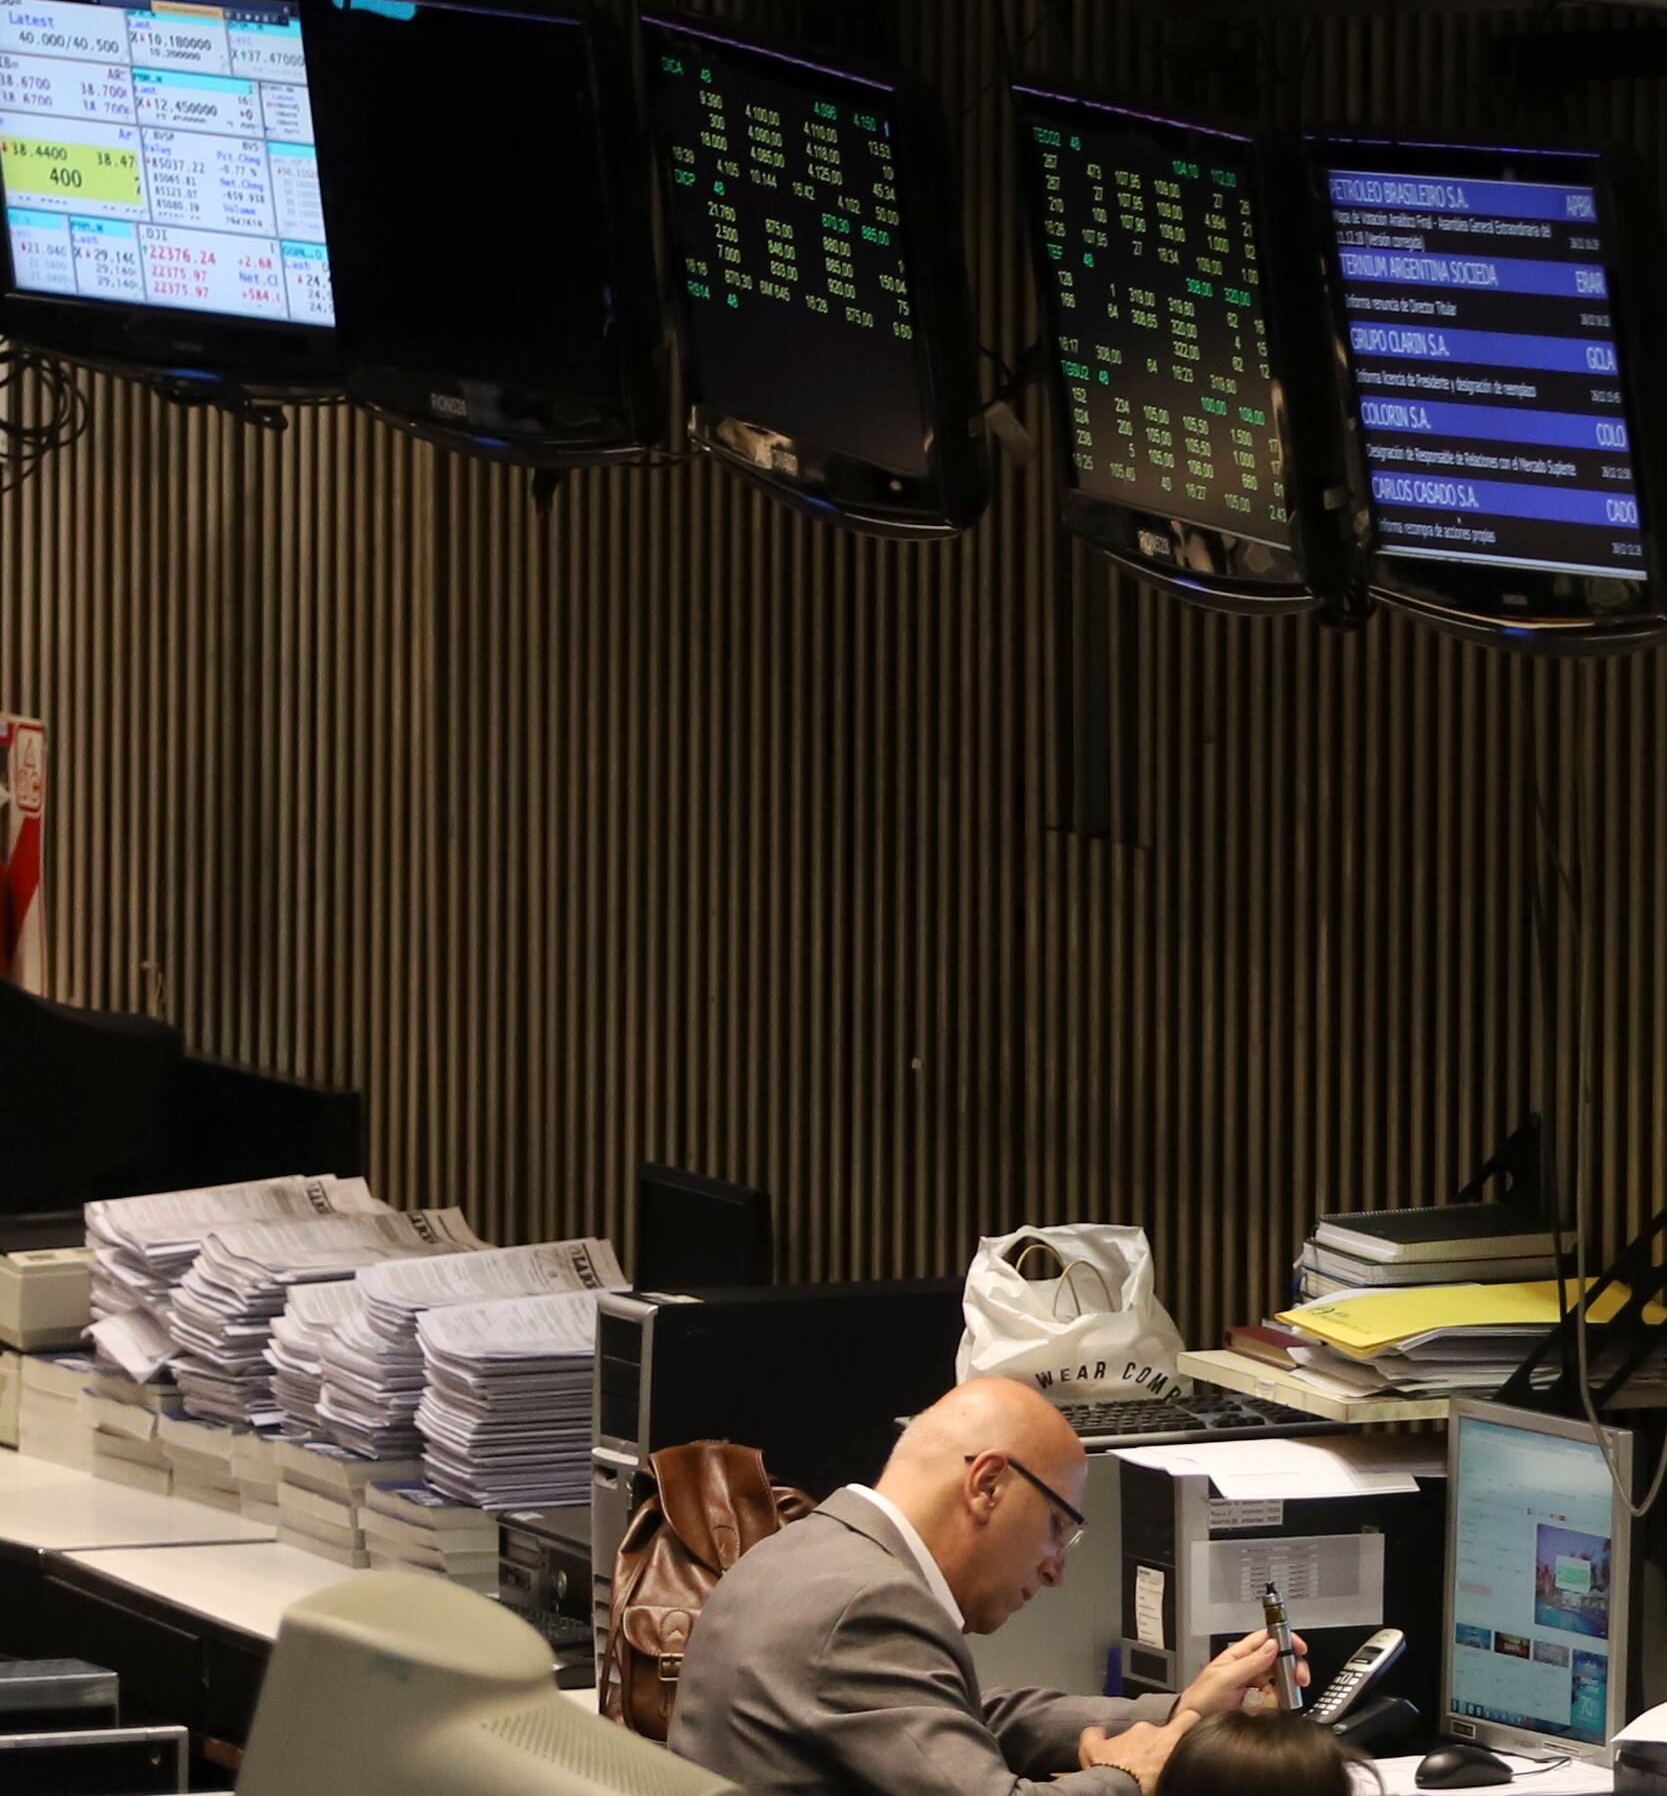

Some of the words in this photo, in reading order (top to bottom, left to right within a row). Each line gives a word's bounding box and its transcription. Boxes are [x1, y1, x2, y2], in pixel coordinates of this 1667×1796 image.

[9, 11, 55, 29] Latest
[50, 167, 82, 188] 400
[1390, 257, 1450, 283] ARGENTINA
[1351, 328, 1387, 351] GRUPO
[1372, 477, 1413, 502] CARLOS
[1414, 481, 1457, 506] CASADO
[1036, 1361, 1106, 1388] WEAR
